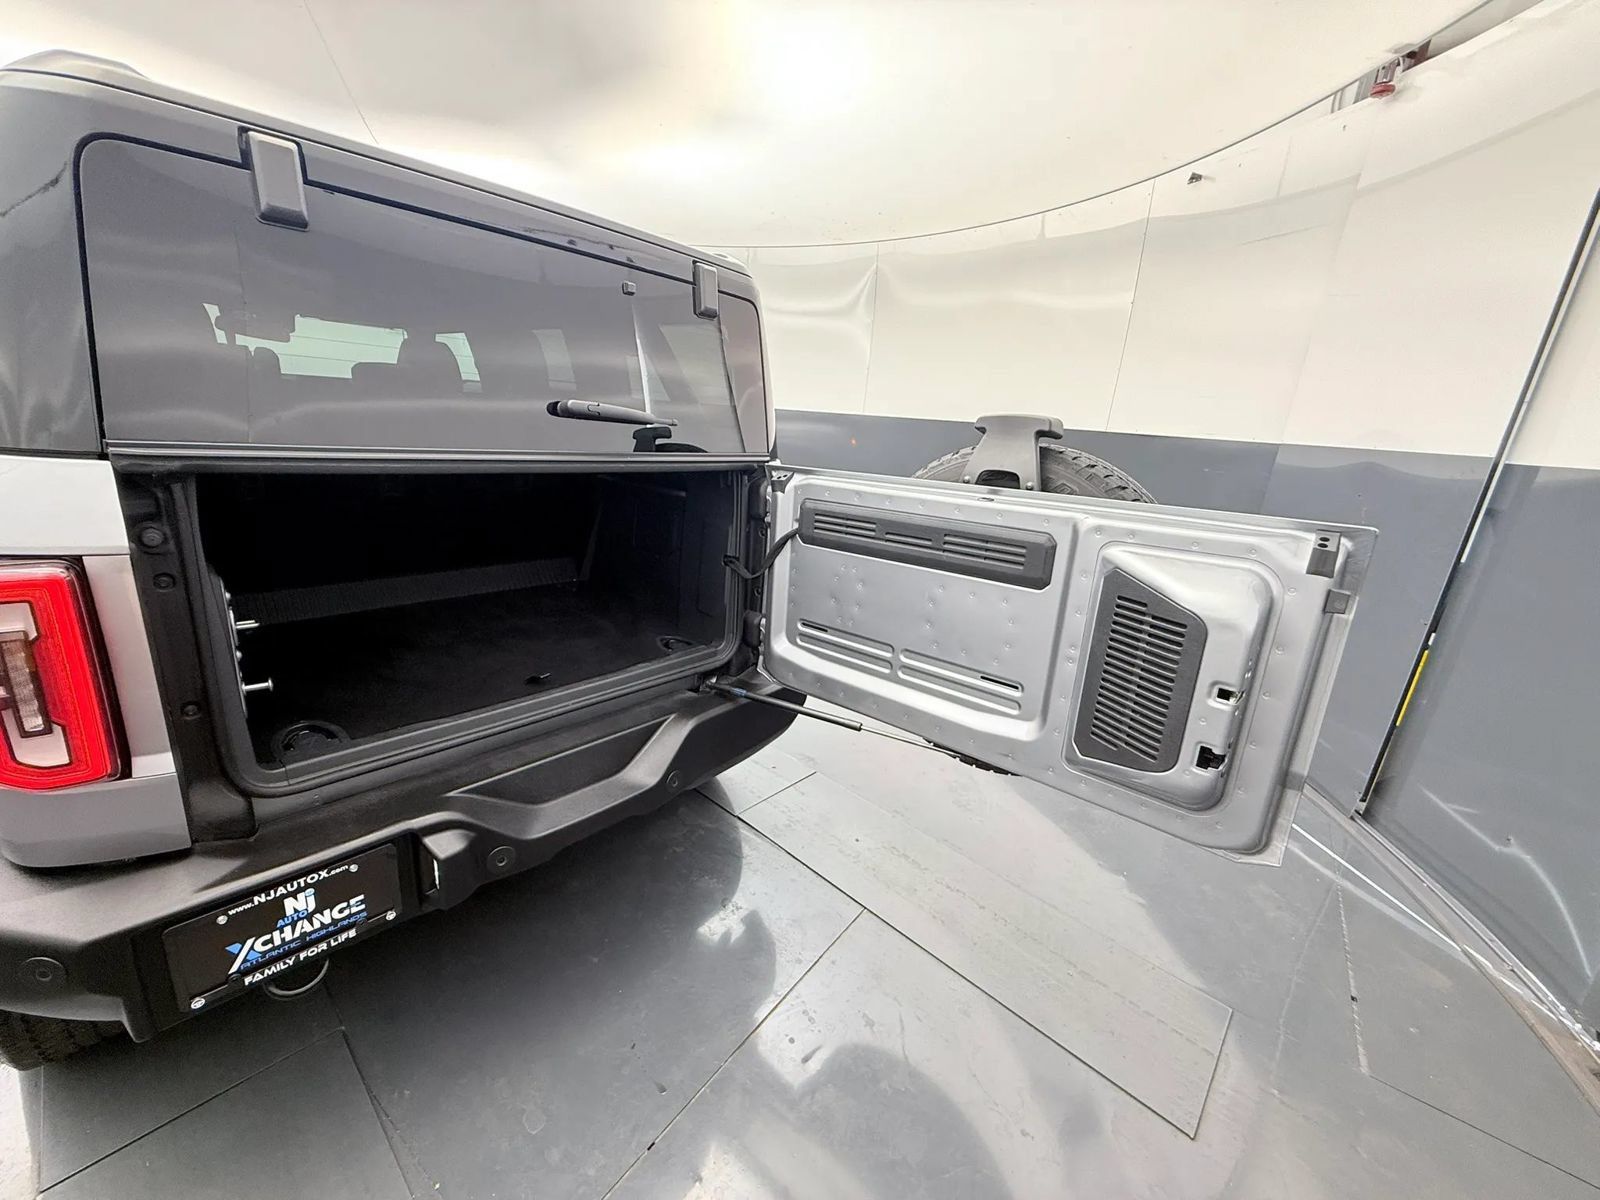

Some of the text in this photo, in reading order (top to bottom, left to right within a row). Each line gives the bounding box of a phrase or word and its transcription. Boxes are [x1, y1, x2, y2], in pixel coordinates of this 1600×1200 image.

[228, 864, 349, 915] www.NJAUTOX.com
[276, 909, 308, 928] AUTO
[225, 894, 366, 975] XCHANGE
[240, 911, 367, 970] ATLANTIC HIGHLANDS
[244, 928, 358, 986] FAMILY FOR LIFE
